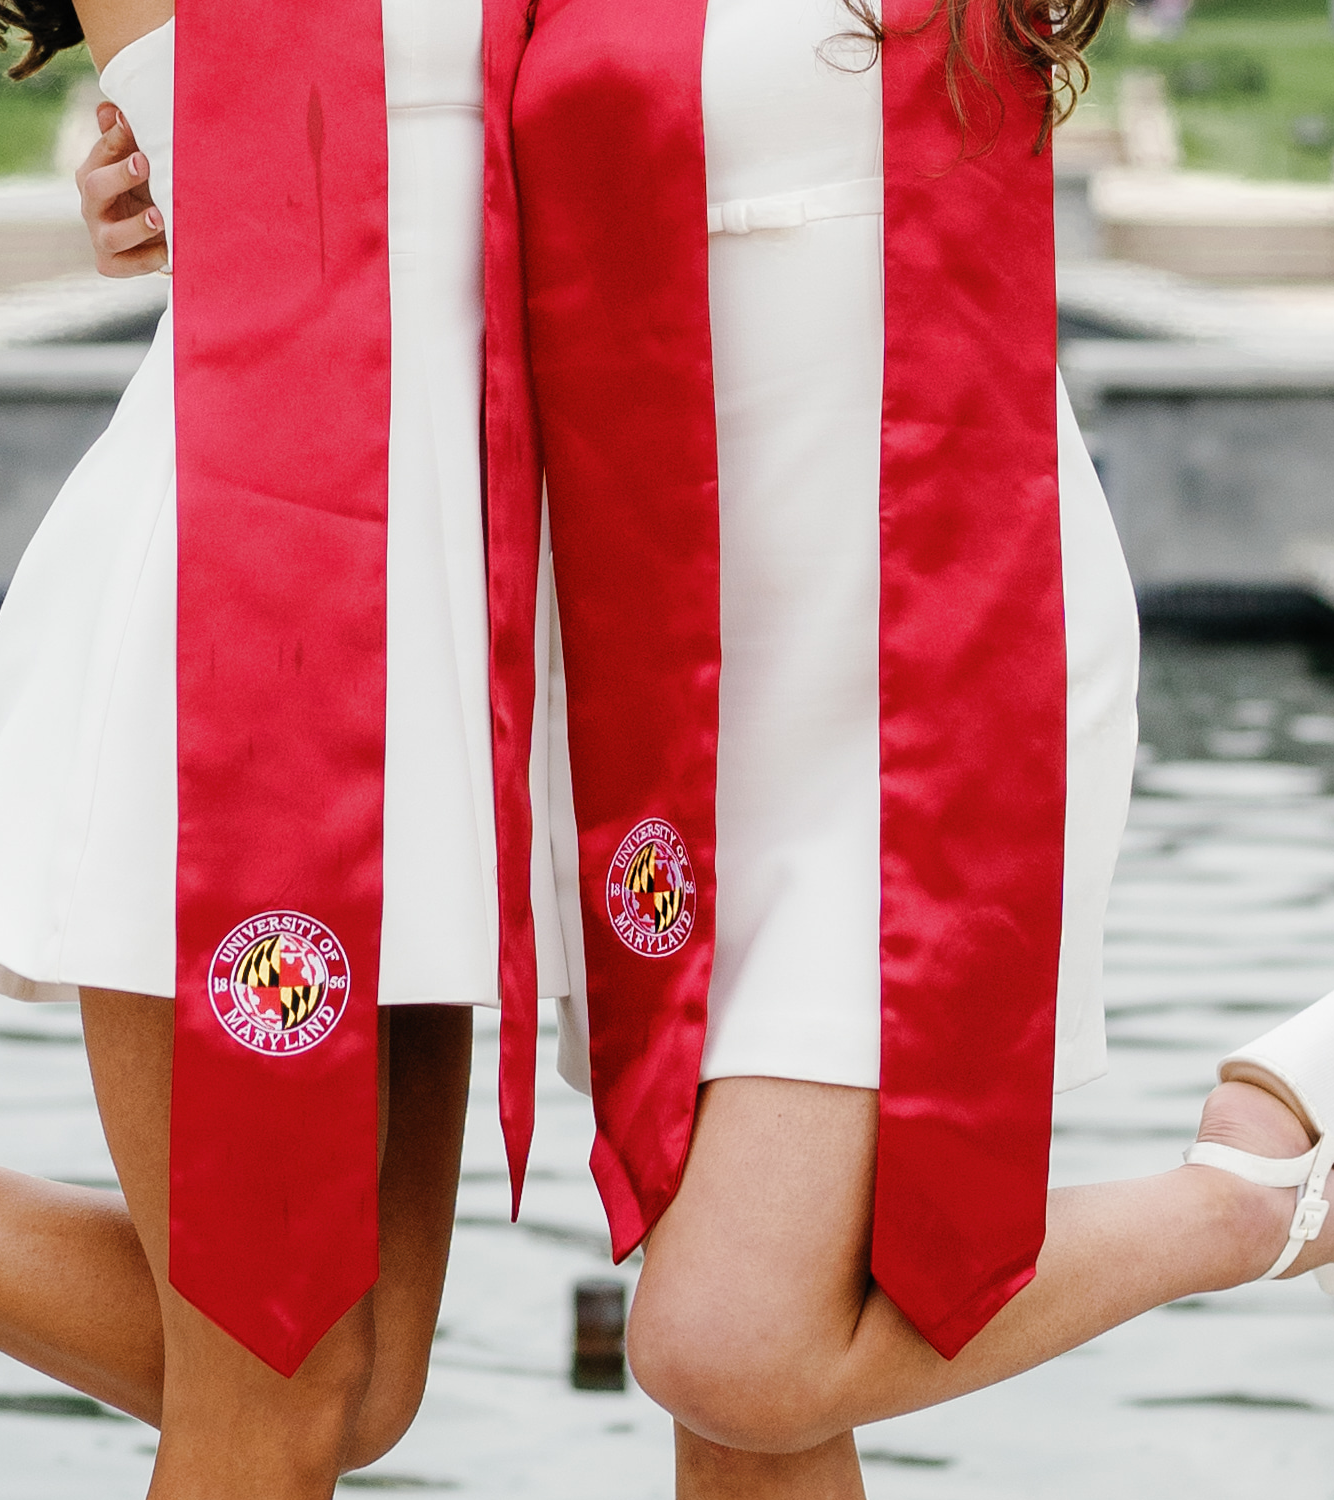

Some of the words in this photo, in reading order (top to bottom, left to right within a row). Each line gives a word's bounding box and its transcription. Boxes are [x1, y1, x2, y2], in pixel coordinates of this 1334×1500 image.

[615, 823, 677, 869] UNIVERSITY
[677, 845, 688, 867] OF
[611, 883, 620, 898] 18
[220, 917, 321, 963] UNIVERSITY
[319, 938, 340, 962] OF
[614, 910, 692, 952] MARYLAND
[215, 977, 228, 994] 18
[329, 976, 346, 989] 56
[223, 1005, 336, 1050] MARYLAND
